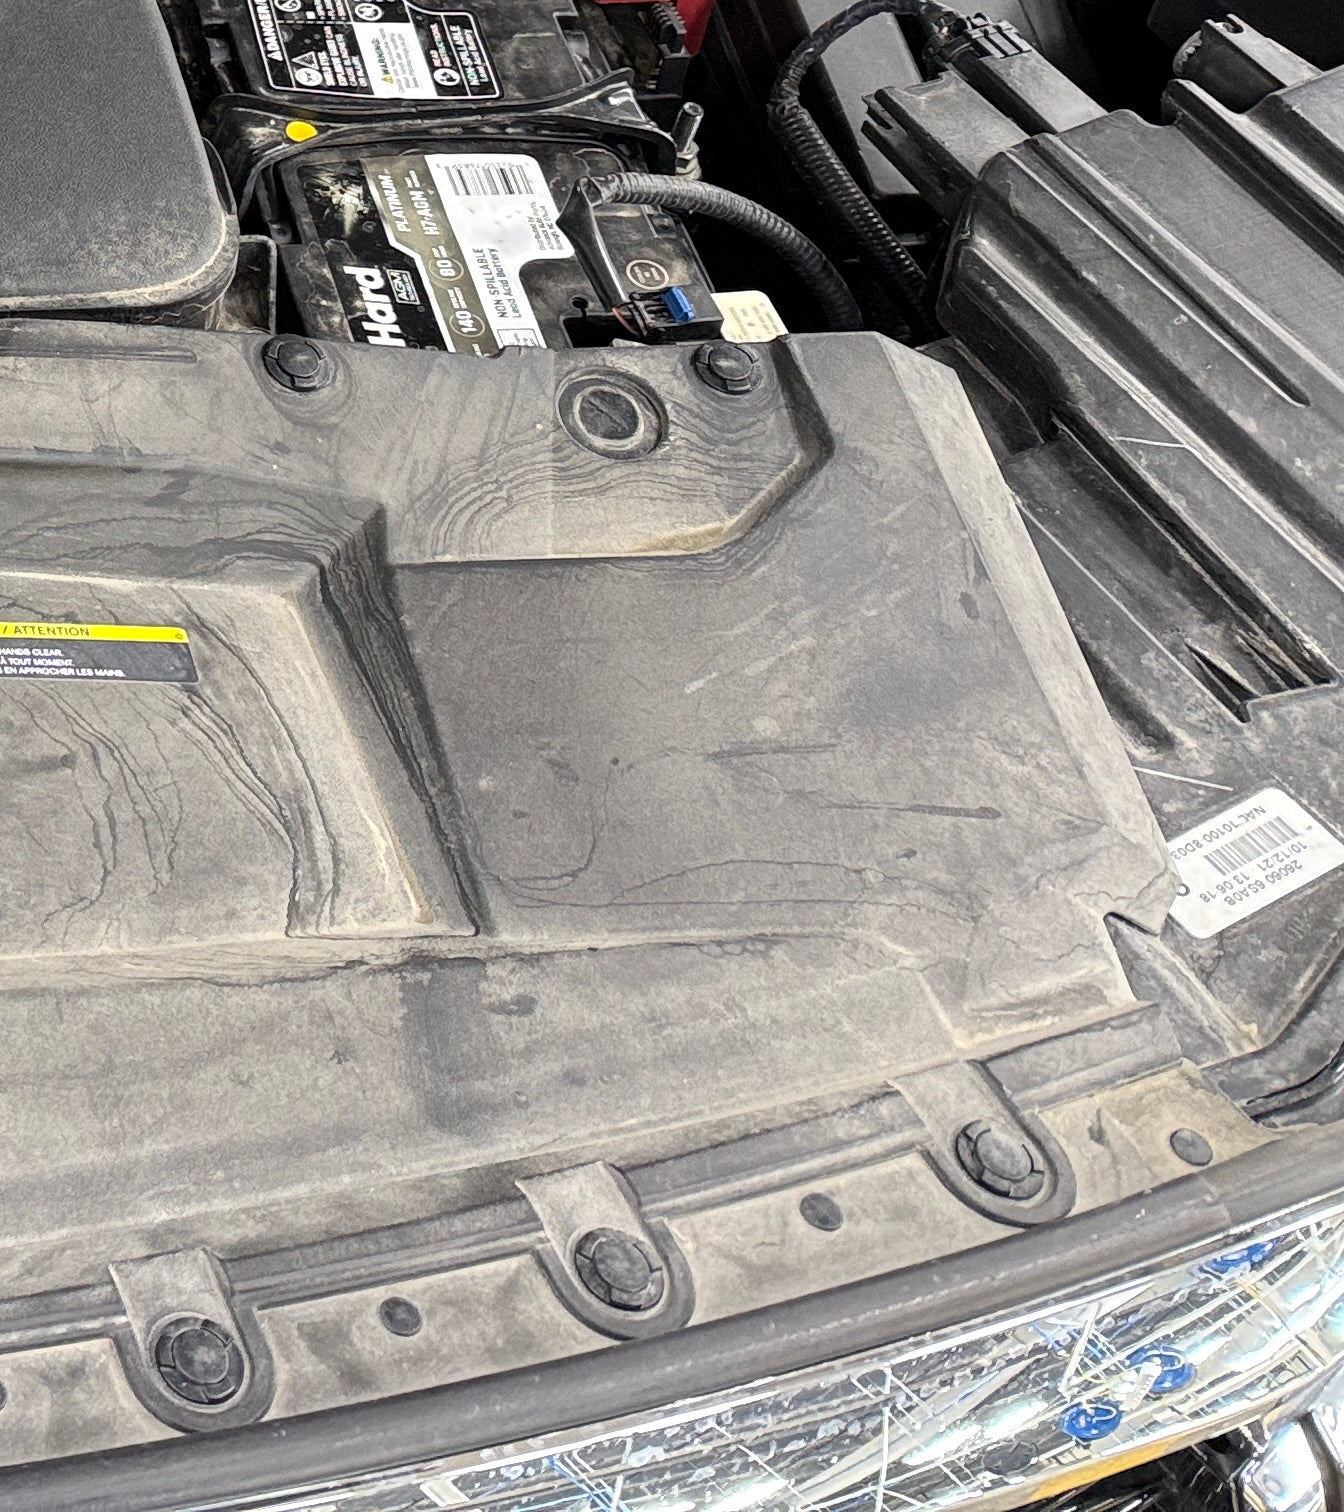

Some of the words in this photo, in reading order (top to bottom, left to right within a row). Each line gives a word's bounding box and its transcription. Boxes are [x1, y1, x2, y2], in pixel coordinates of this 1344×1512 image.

[450, 25, 480, 86] NON-SPILLABLE
[378, 174, 412, 232] PLATINUM
[436, 259, 456, 277] 80
[487, 248, 507, 277] Battery
[389, 272, 408, 300] AGM
[496, 280, 513, 296] Acid
[504, 299, 522, 318] Lead
[456, 311, 478, 333] 140
[14, 626, 90, 636] ATTENTION
[8, 658, 34, 666] TOUT
[19, 668, 75, 676] APPROCHER
[1257, 842, 1307, 871] 10/12/21
